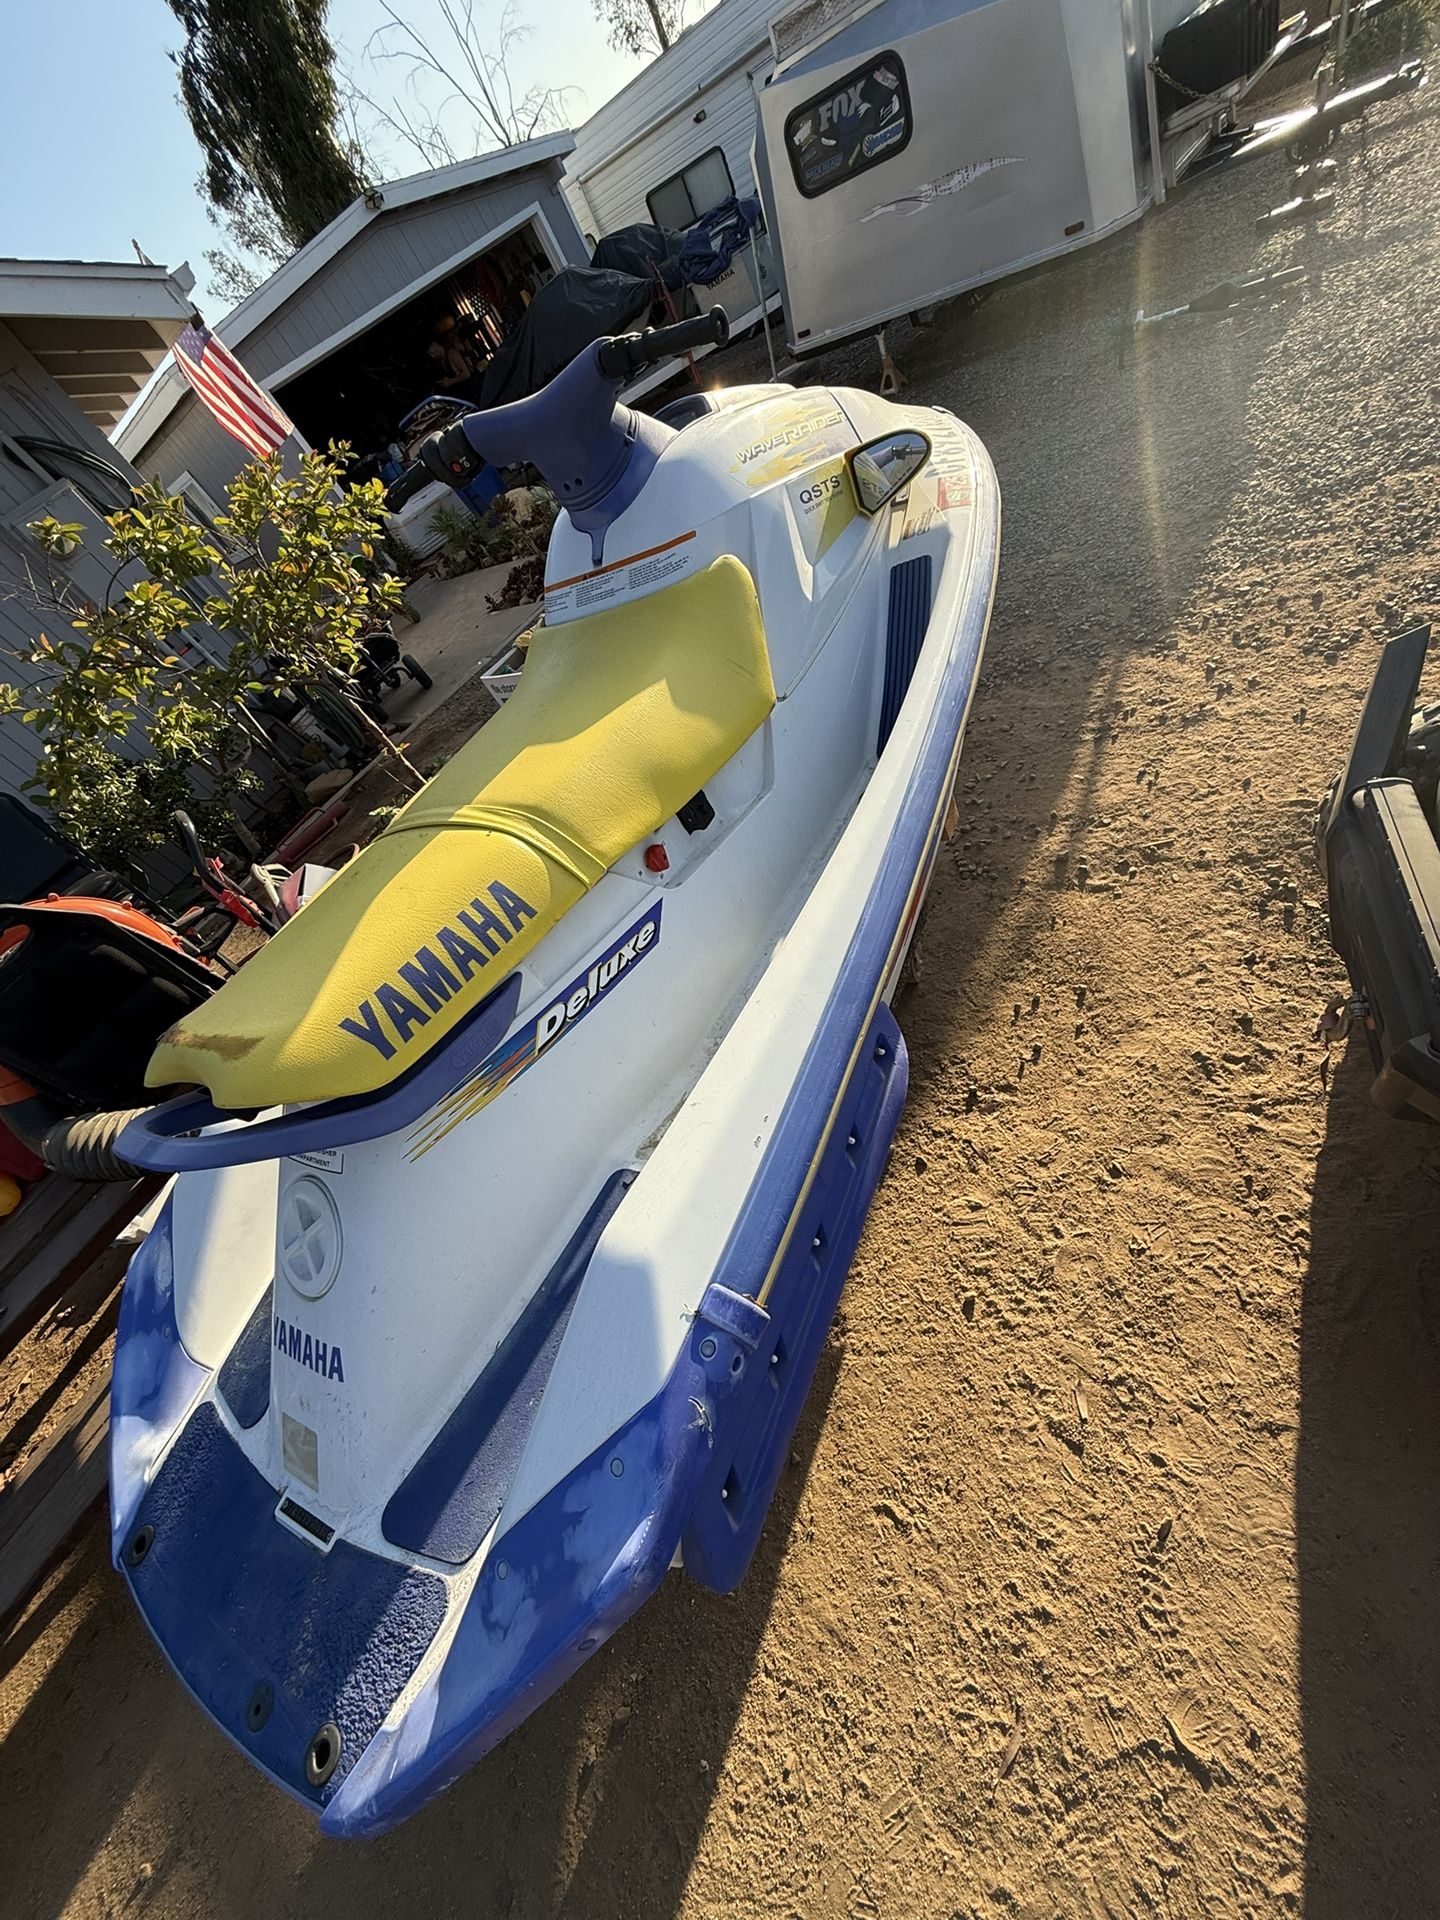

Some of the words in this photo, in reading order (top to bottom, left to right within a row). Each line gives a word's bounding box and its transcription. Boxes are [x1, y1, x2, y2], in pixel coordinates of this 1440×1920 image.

[818, 79, 866, 132] FOX
[706, 268, 735, 291] YAMAHA
[799, 475, 841, 504] QSTS
[338, 880, 538, 1061] YAMAHA
[534, 920, 656, 1056] Deluxe
[274, 1316, 344, 1383] YAMAHA
